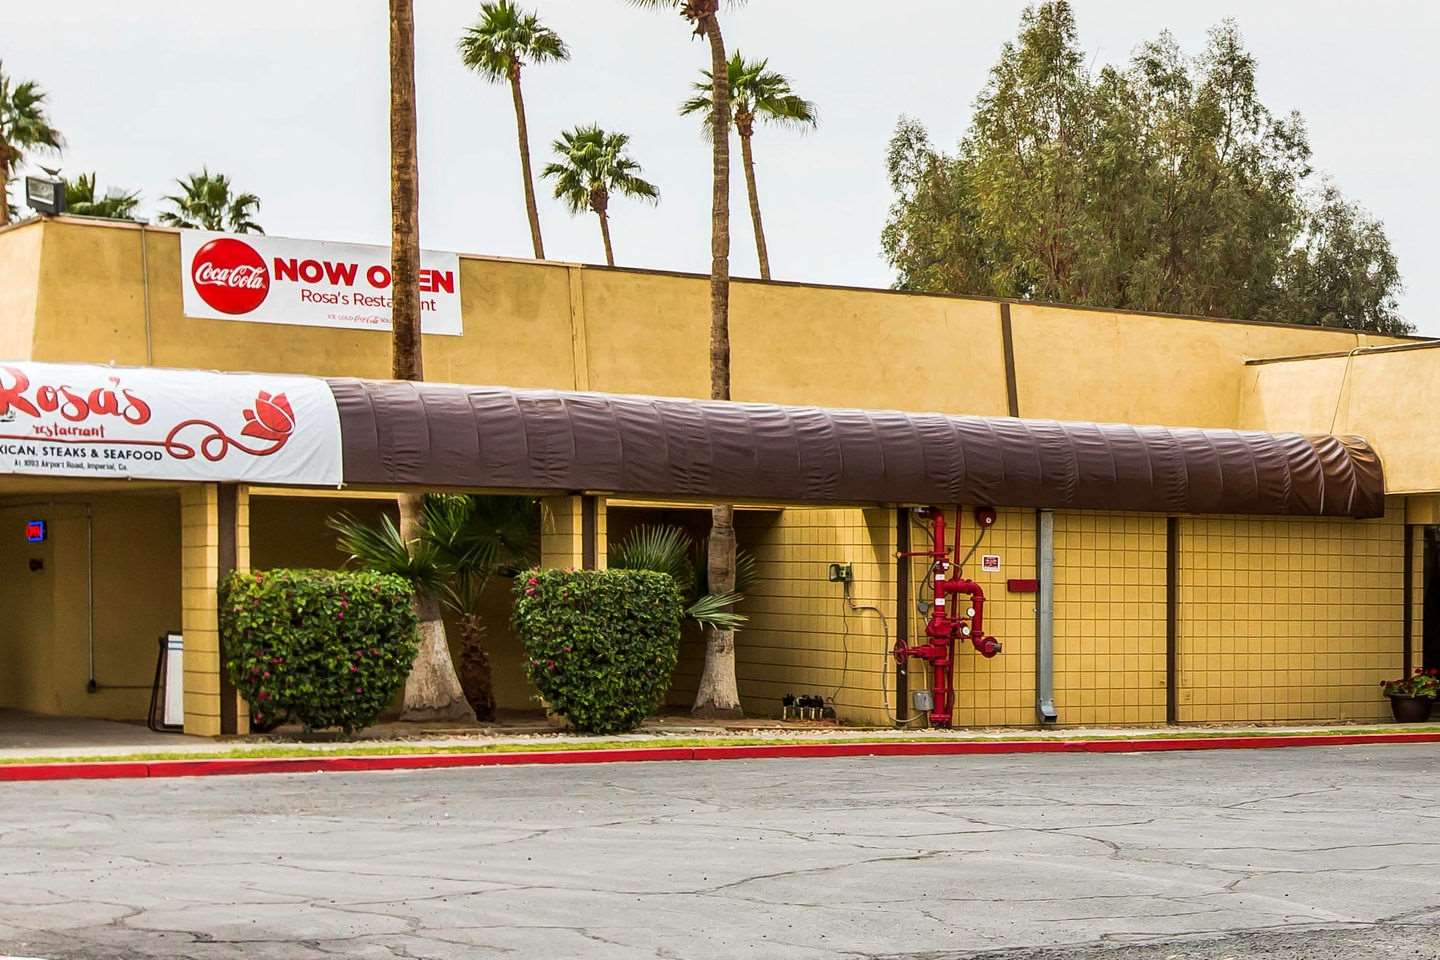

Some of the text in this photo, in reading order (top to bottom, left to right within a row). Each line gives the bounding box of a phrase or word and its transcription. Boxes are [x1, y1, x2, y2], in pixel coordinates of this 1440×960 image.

[273, 257, 455, 294] NOW OEN
[301, 289, 437, 312] Rosa's Restant
[42, 446, 87, 458] STEAKS
[90, 449, 99, 458] &
[103, 449, 163, 461] SEAFOOD
